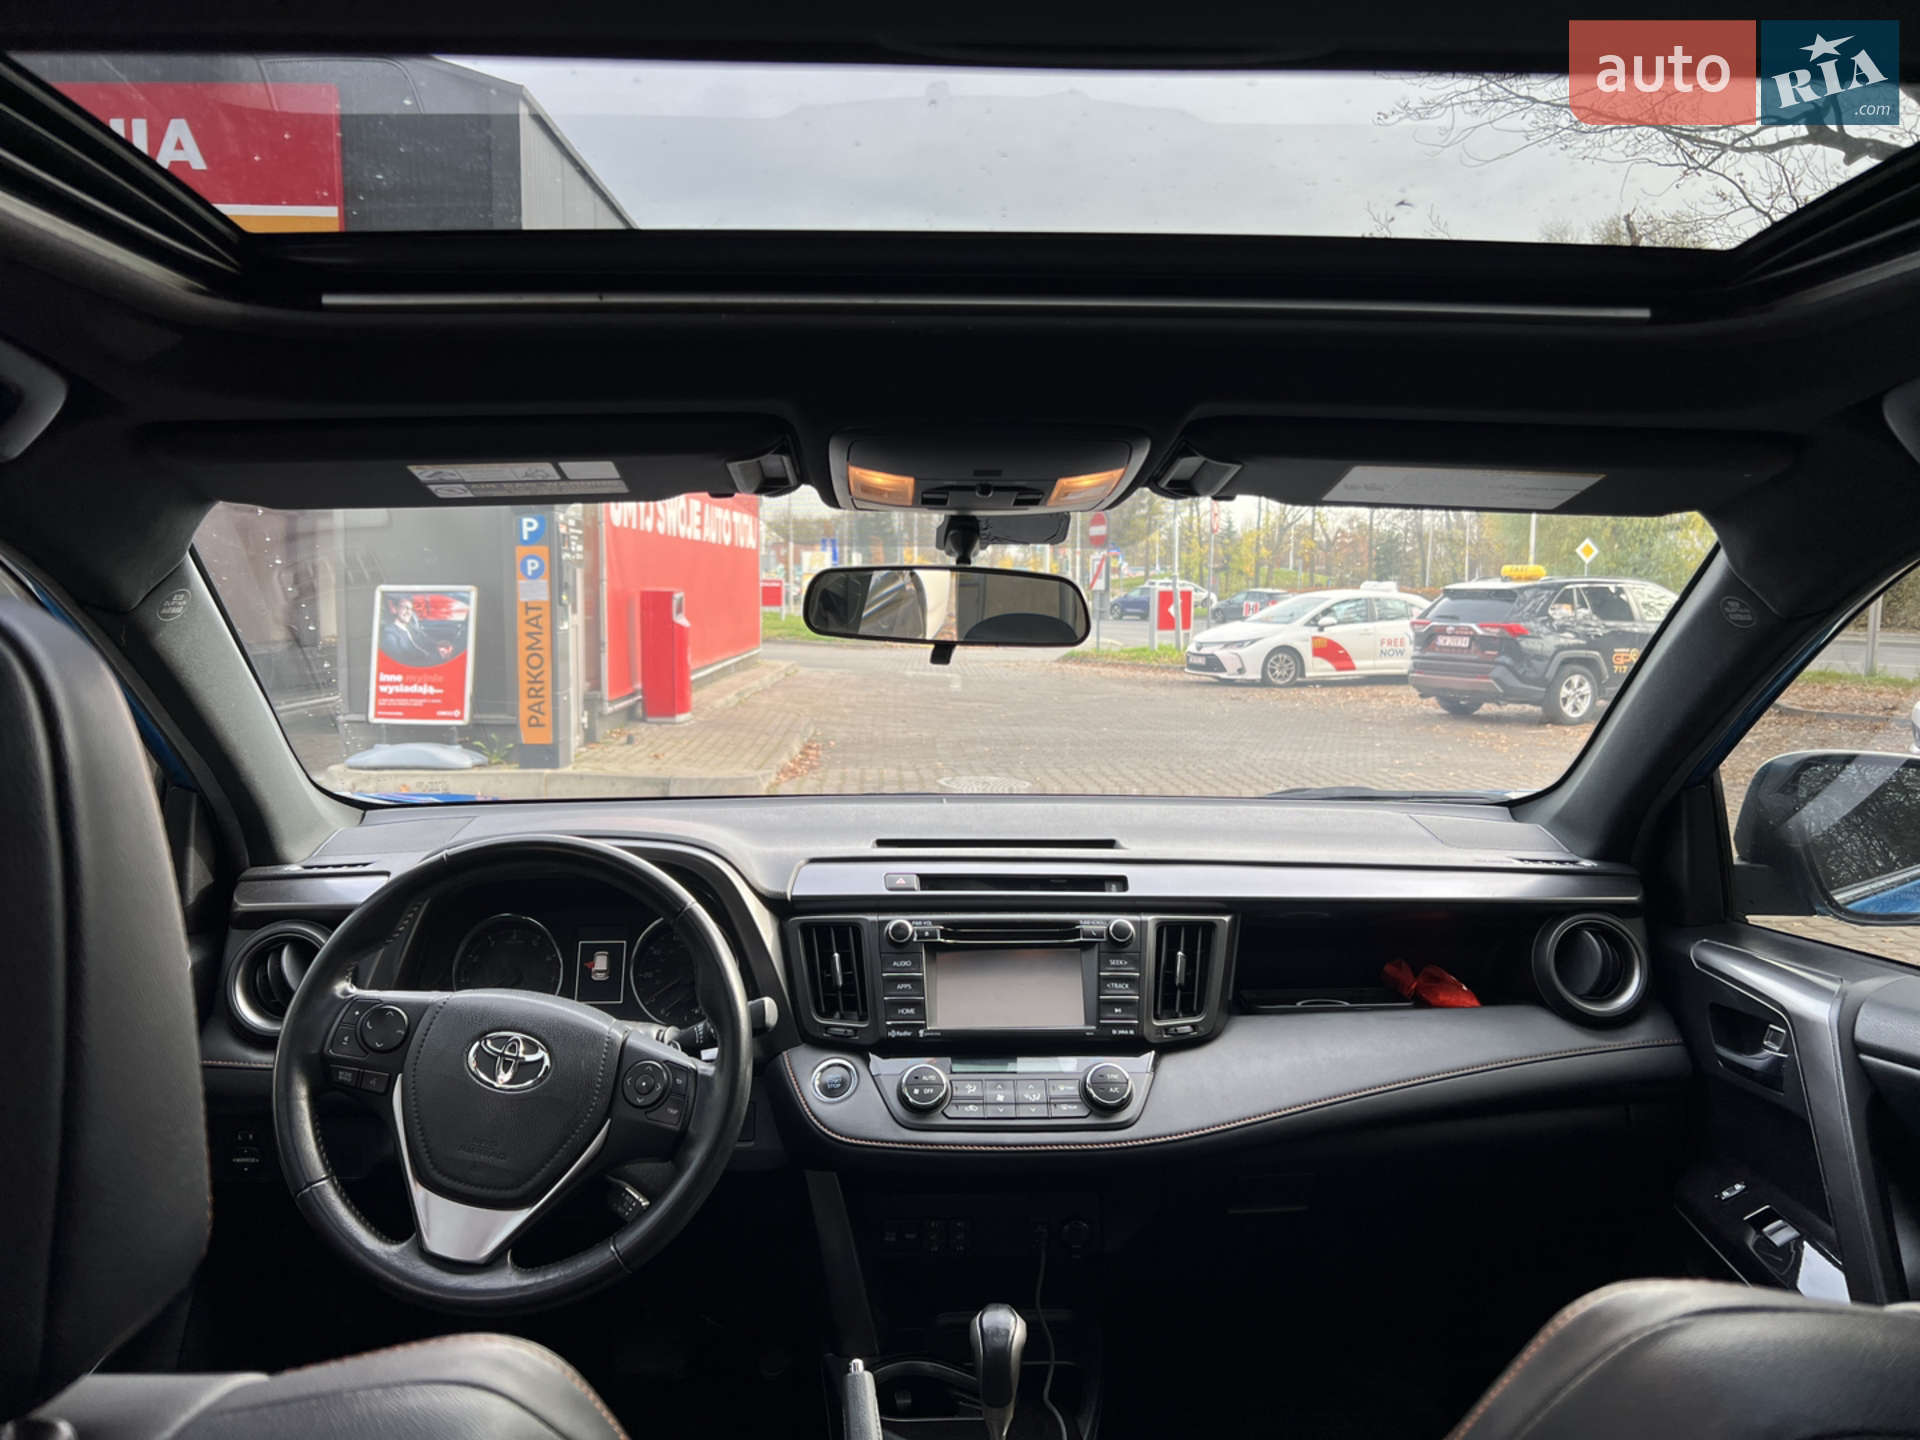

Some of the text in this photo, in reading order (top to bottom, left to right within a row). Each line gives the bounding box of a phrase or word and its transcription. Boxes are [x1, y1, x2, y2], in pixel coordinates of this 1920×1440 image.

[656, 495, 701, 542] SWOJE
[703, 503, 731, 547] AUTO
[521, 517, 539, 541] P
[526, 559, 540, 577] P
[1380, 638, 1406, 648] FREE
[1380, 648, 1405, 658] NOW
[525, 601, 545, 728] PARKOMAT
[379, 672, 403, 683] inne
[667, 1107, 678, 1115] TRIP
